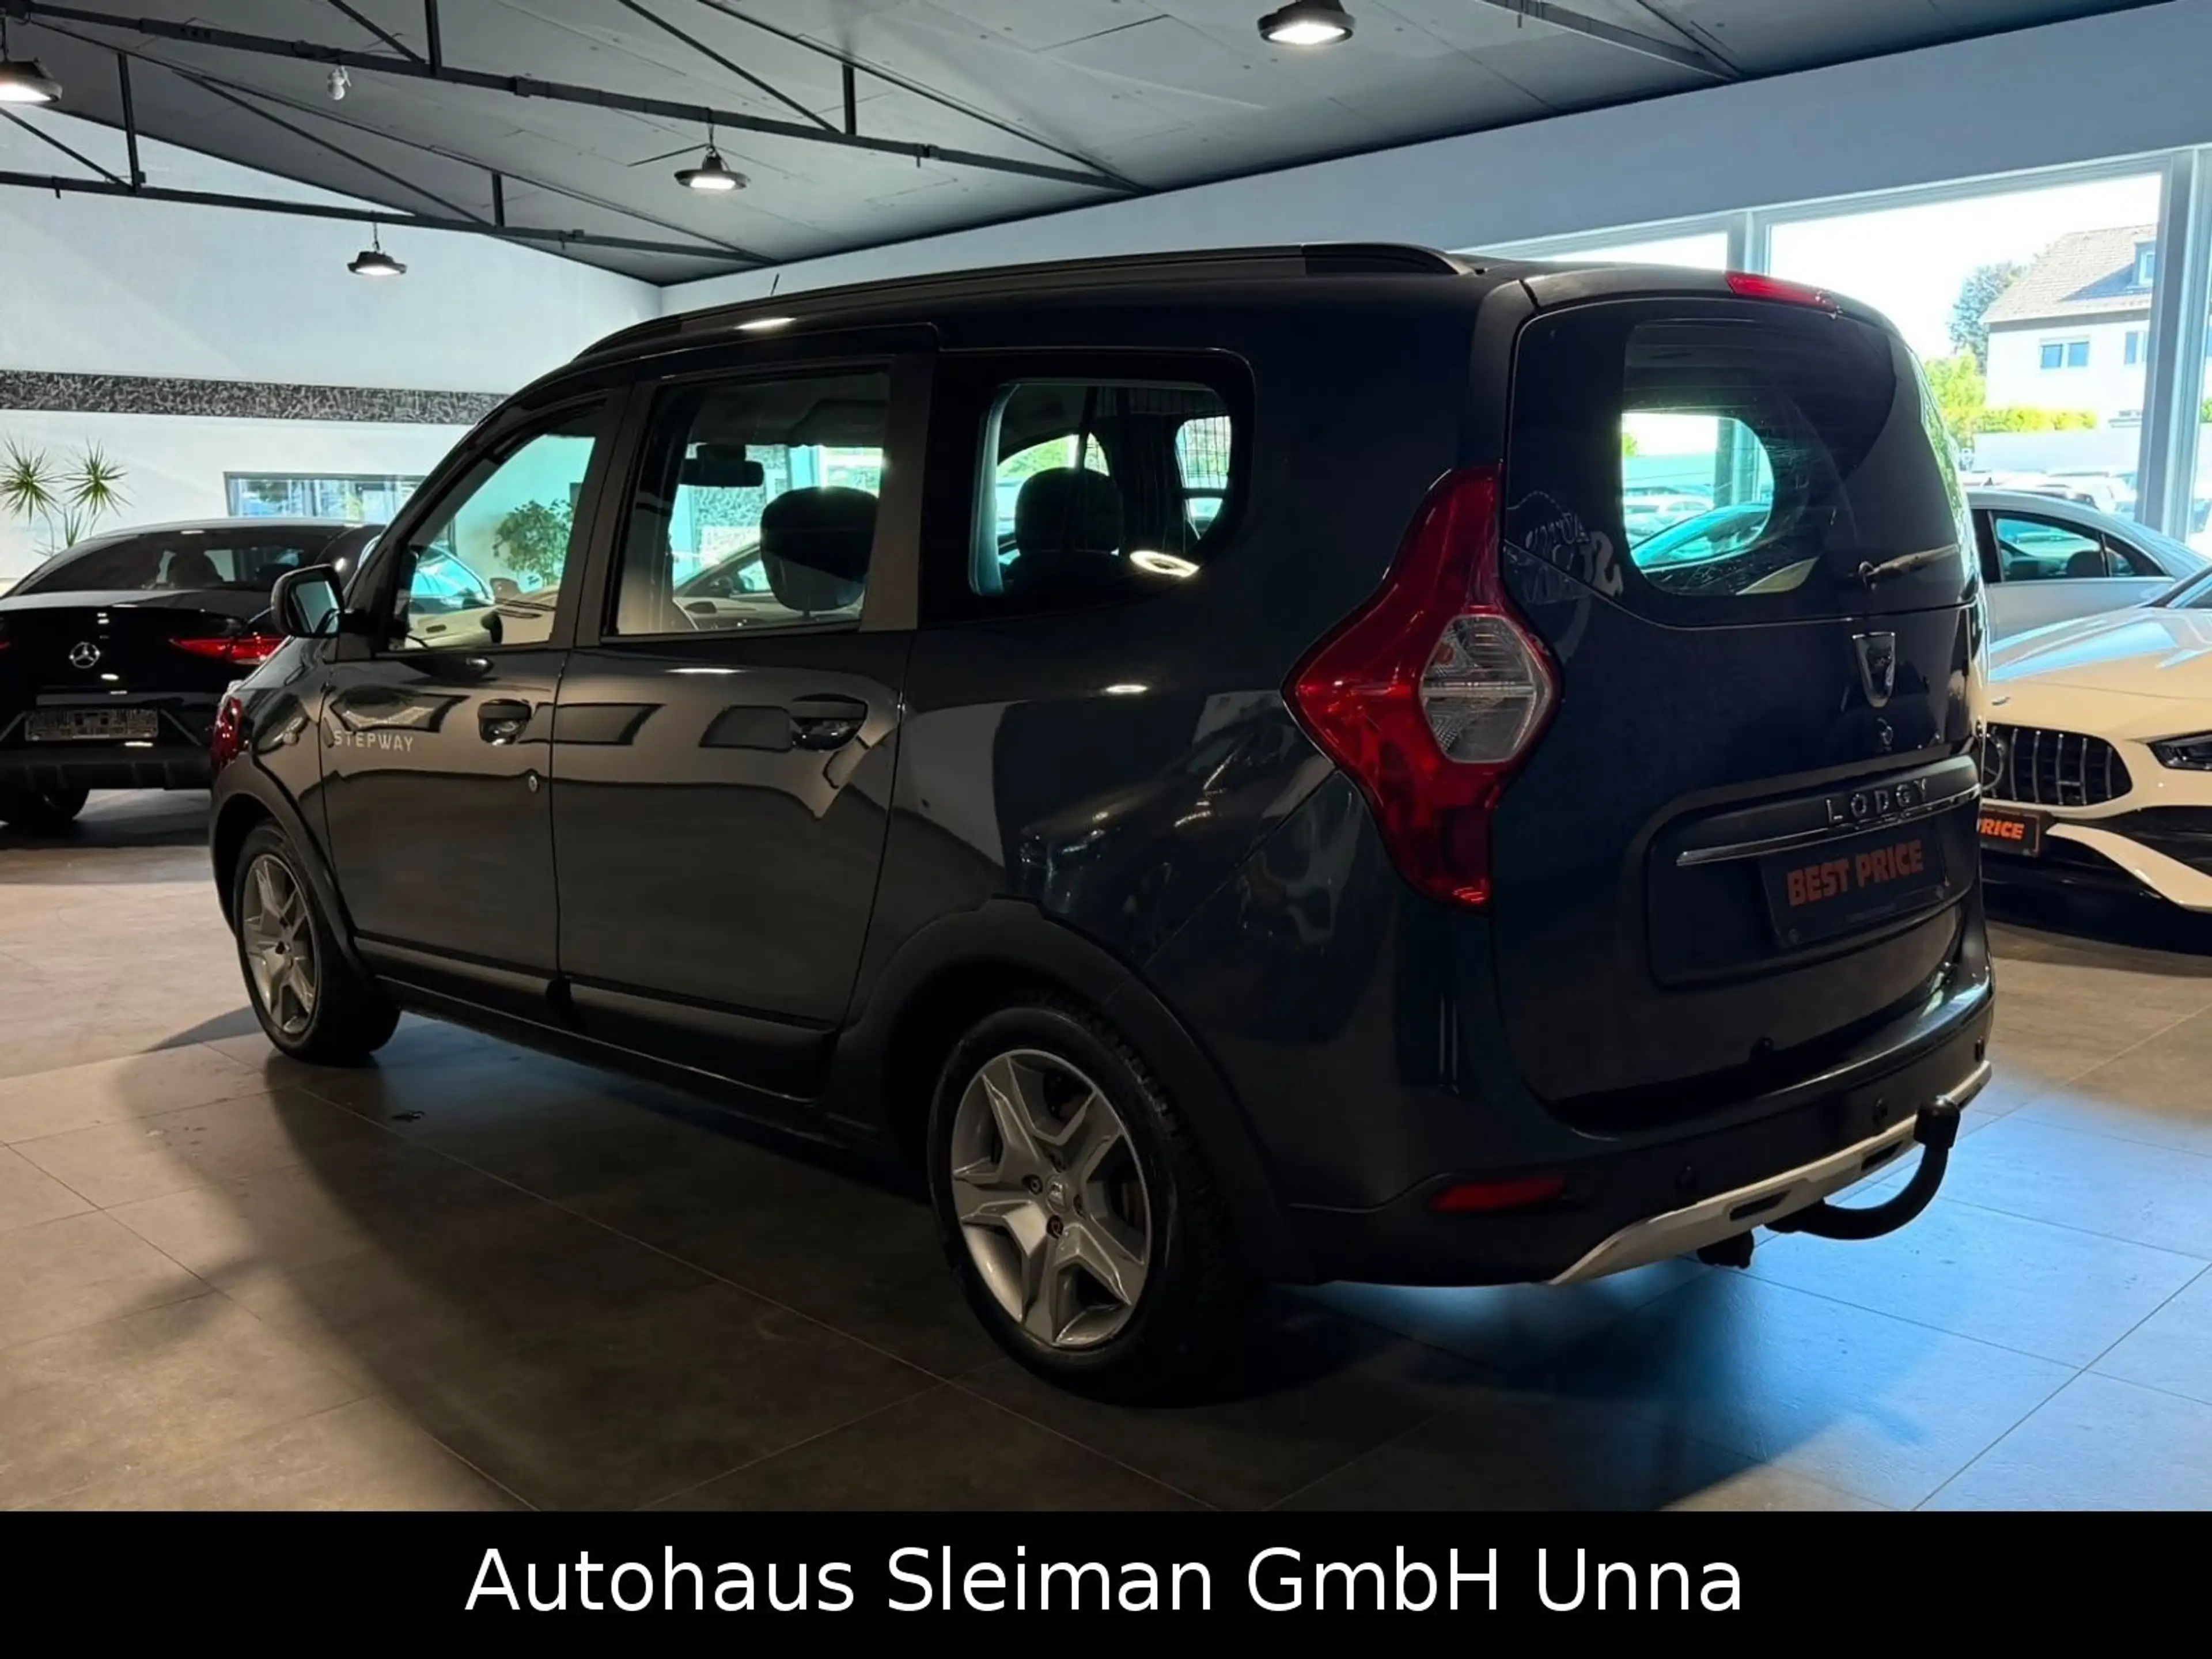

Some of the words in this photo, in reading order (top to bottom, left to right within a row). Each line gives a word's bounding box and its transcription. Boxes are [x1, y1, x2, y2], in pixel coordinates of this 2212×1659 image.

[334, 730, 413, 752] STEPWAY
[1825, 778, 1928, 824] LODGY
[1978, 817, 2025, 841] RICE
[1786, 859, 1850, 907] BEST
[1856, 840, 1924, 888] PRICE
